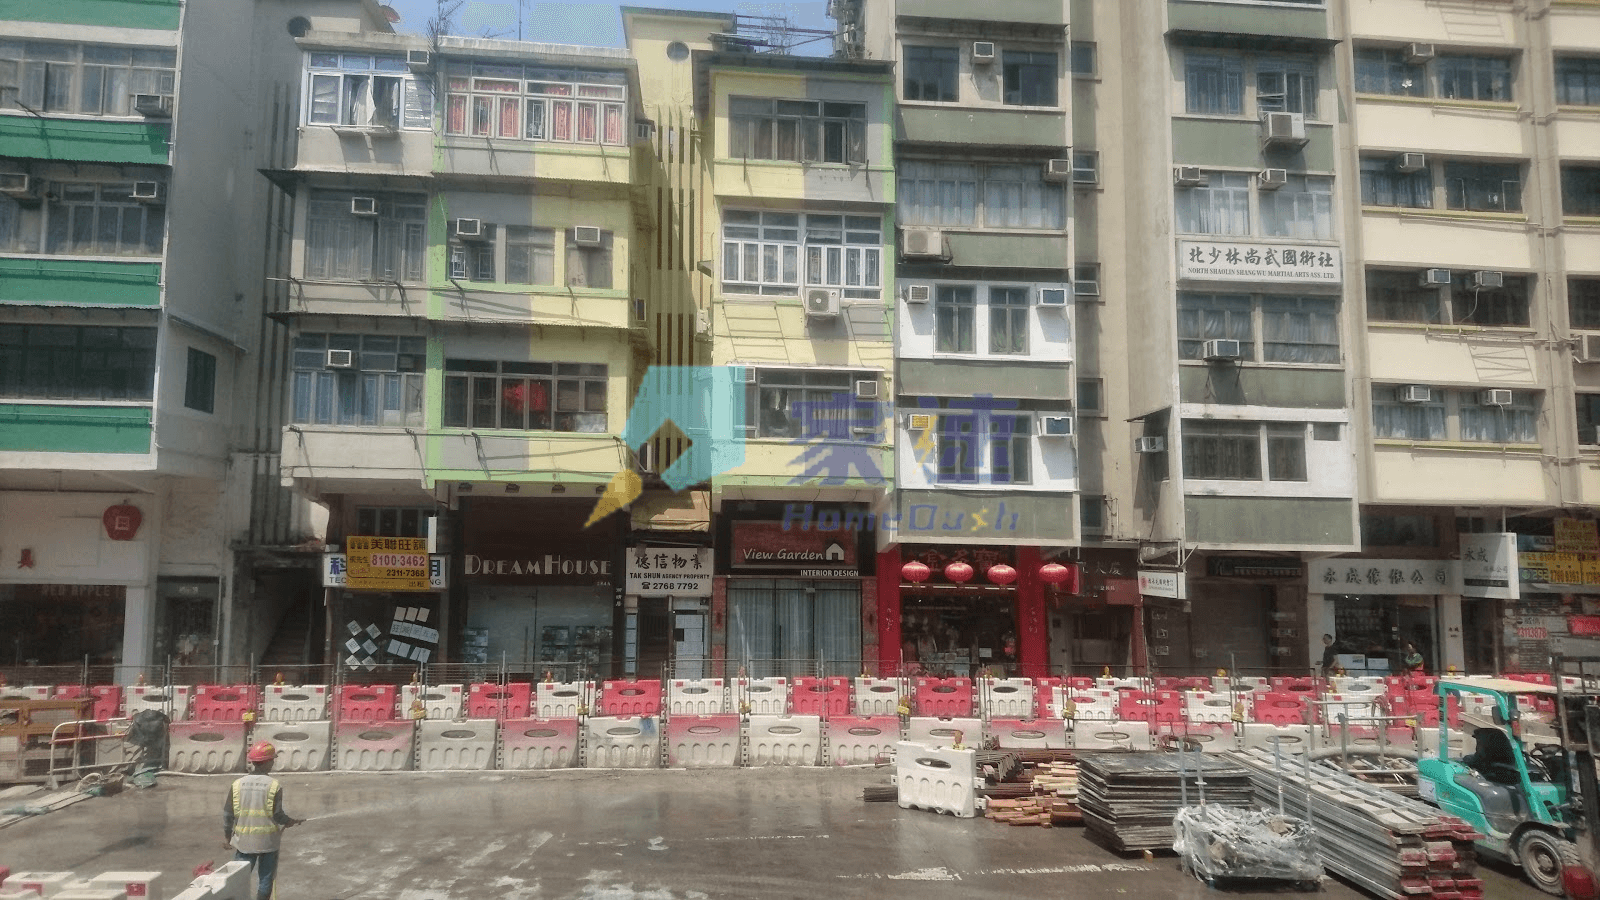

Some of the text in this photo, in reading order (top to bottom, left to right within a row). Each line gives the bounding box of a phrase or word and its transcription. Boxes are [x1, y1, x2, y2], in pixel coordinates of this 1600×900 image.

[1189, 246, 1334, 268] 北少林尚武國術社
[1267, 270, 1294, 278] MARTIAL
[743, 548, 823, 560] View Garden
[800, 569, 833, 577] INTERIOR
[653, 582, 699, 590] 2768 7792
